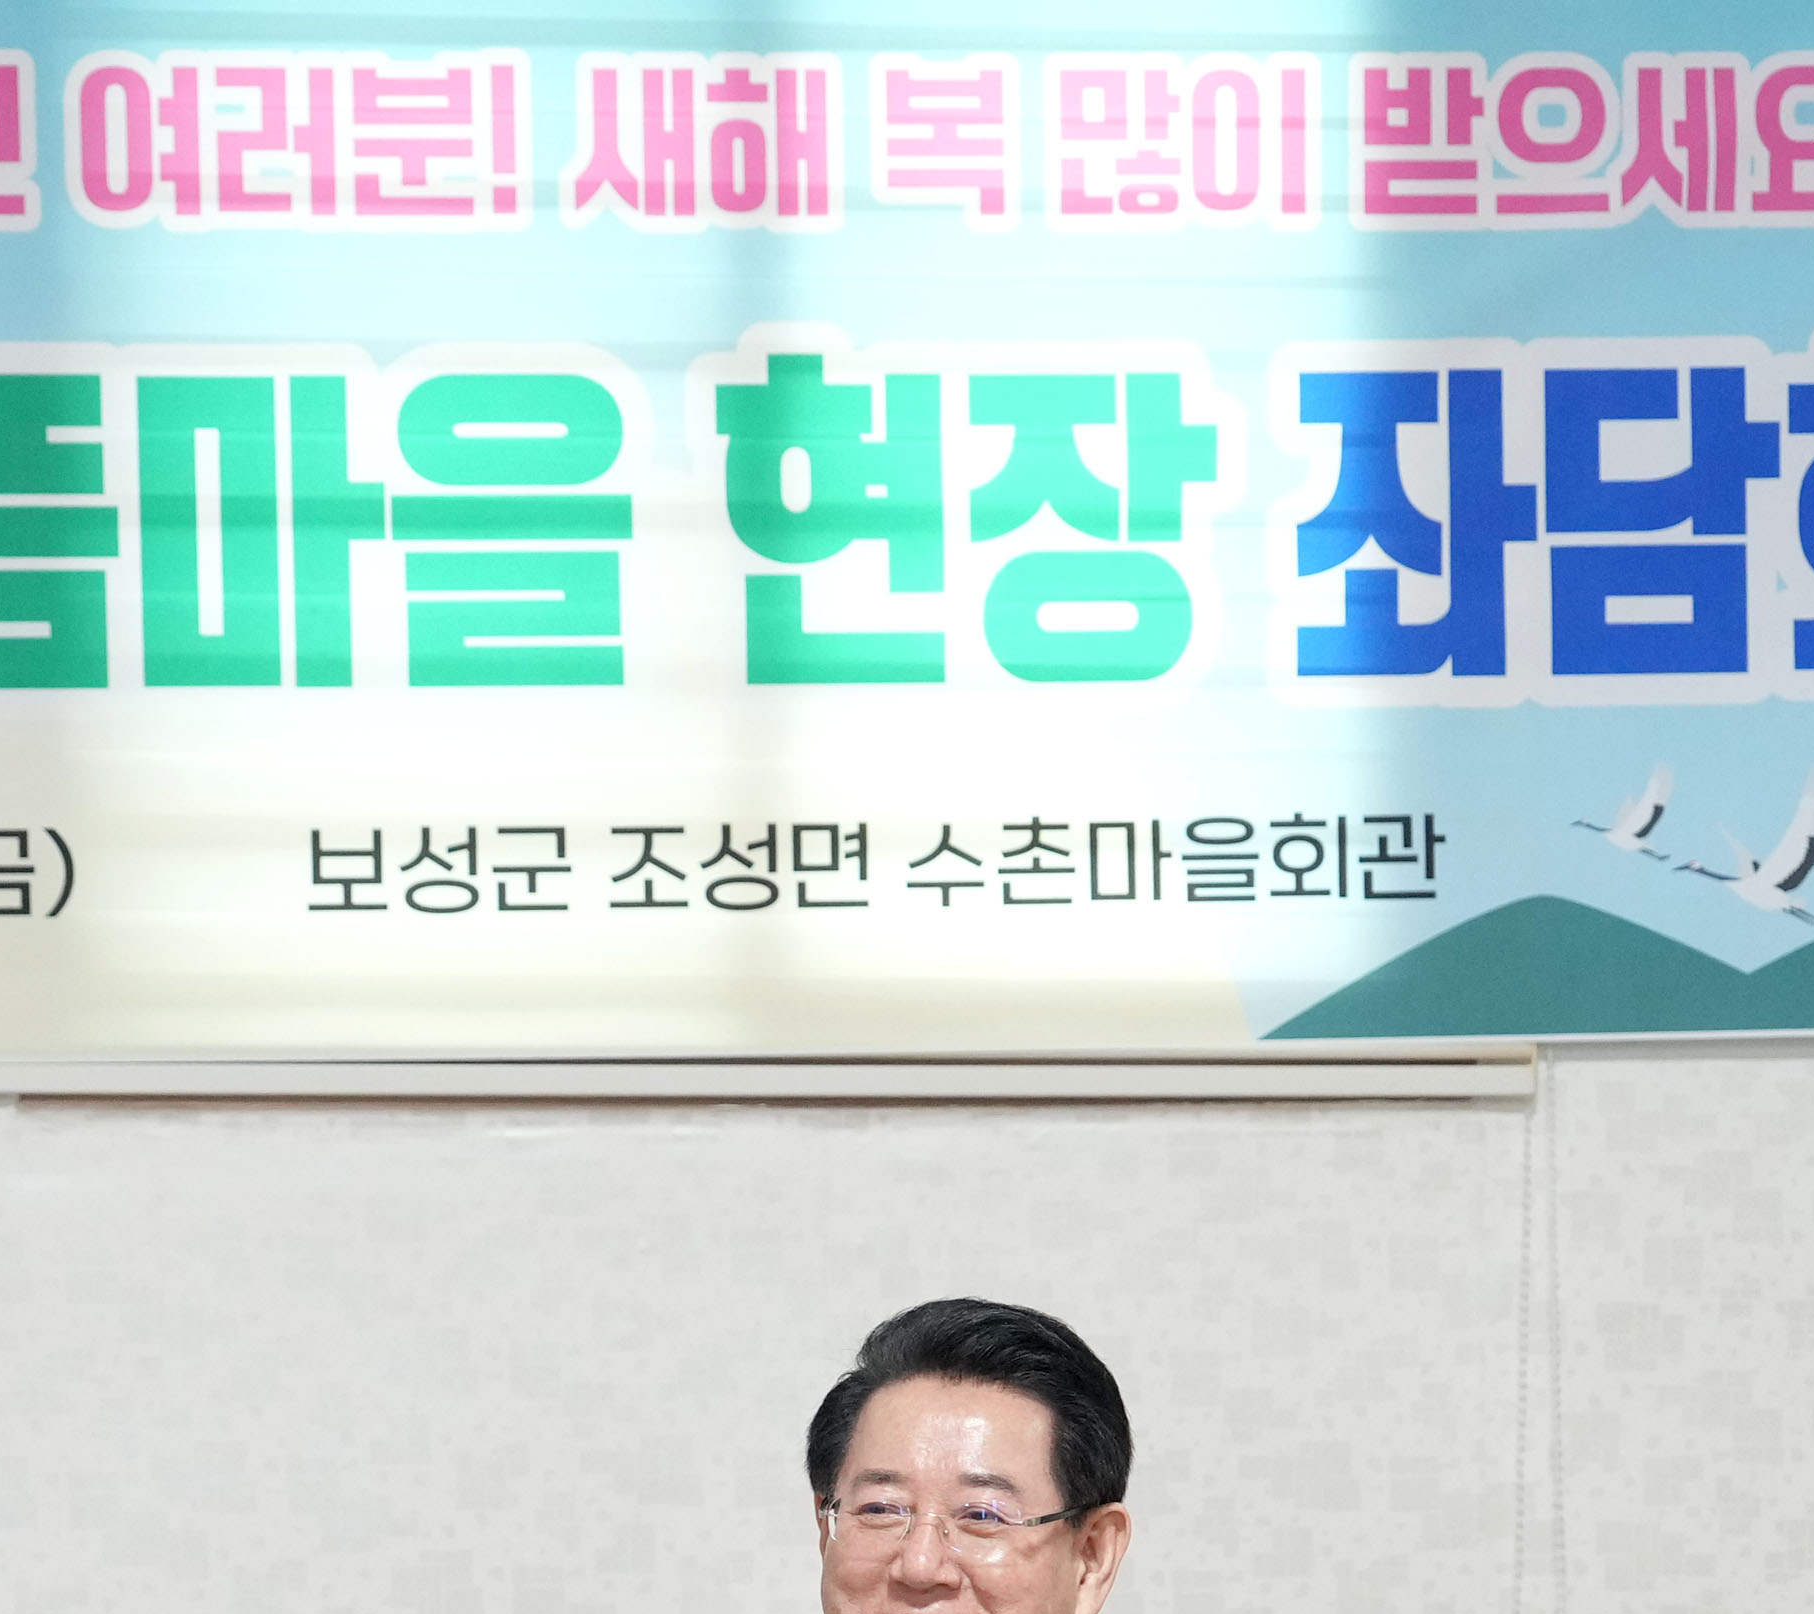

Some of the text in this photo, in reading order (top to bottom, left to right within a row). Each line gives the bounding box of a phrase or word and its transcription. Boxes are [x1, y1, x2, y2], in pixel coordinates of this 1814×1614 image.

[77, 62, 520, 218] 여러분!
[573, 65, 831, 218] 새해
[884, 67, 1008, 217] 복
[1059, 67, 1308, 217] 많이
[714, 352, 1218, 686] 현장
[308, 826, 572, 915] 보성군
[609, 822, 869, 912] 조성면
[906, 812, 1447, 908] 수촌마을회관
